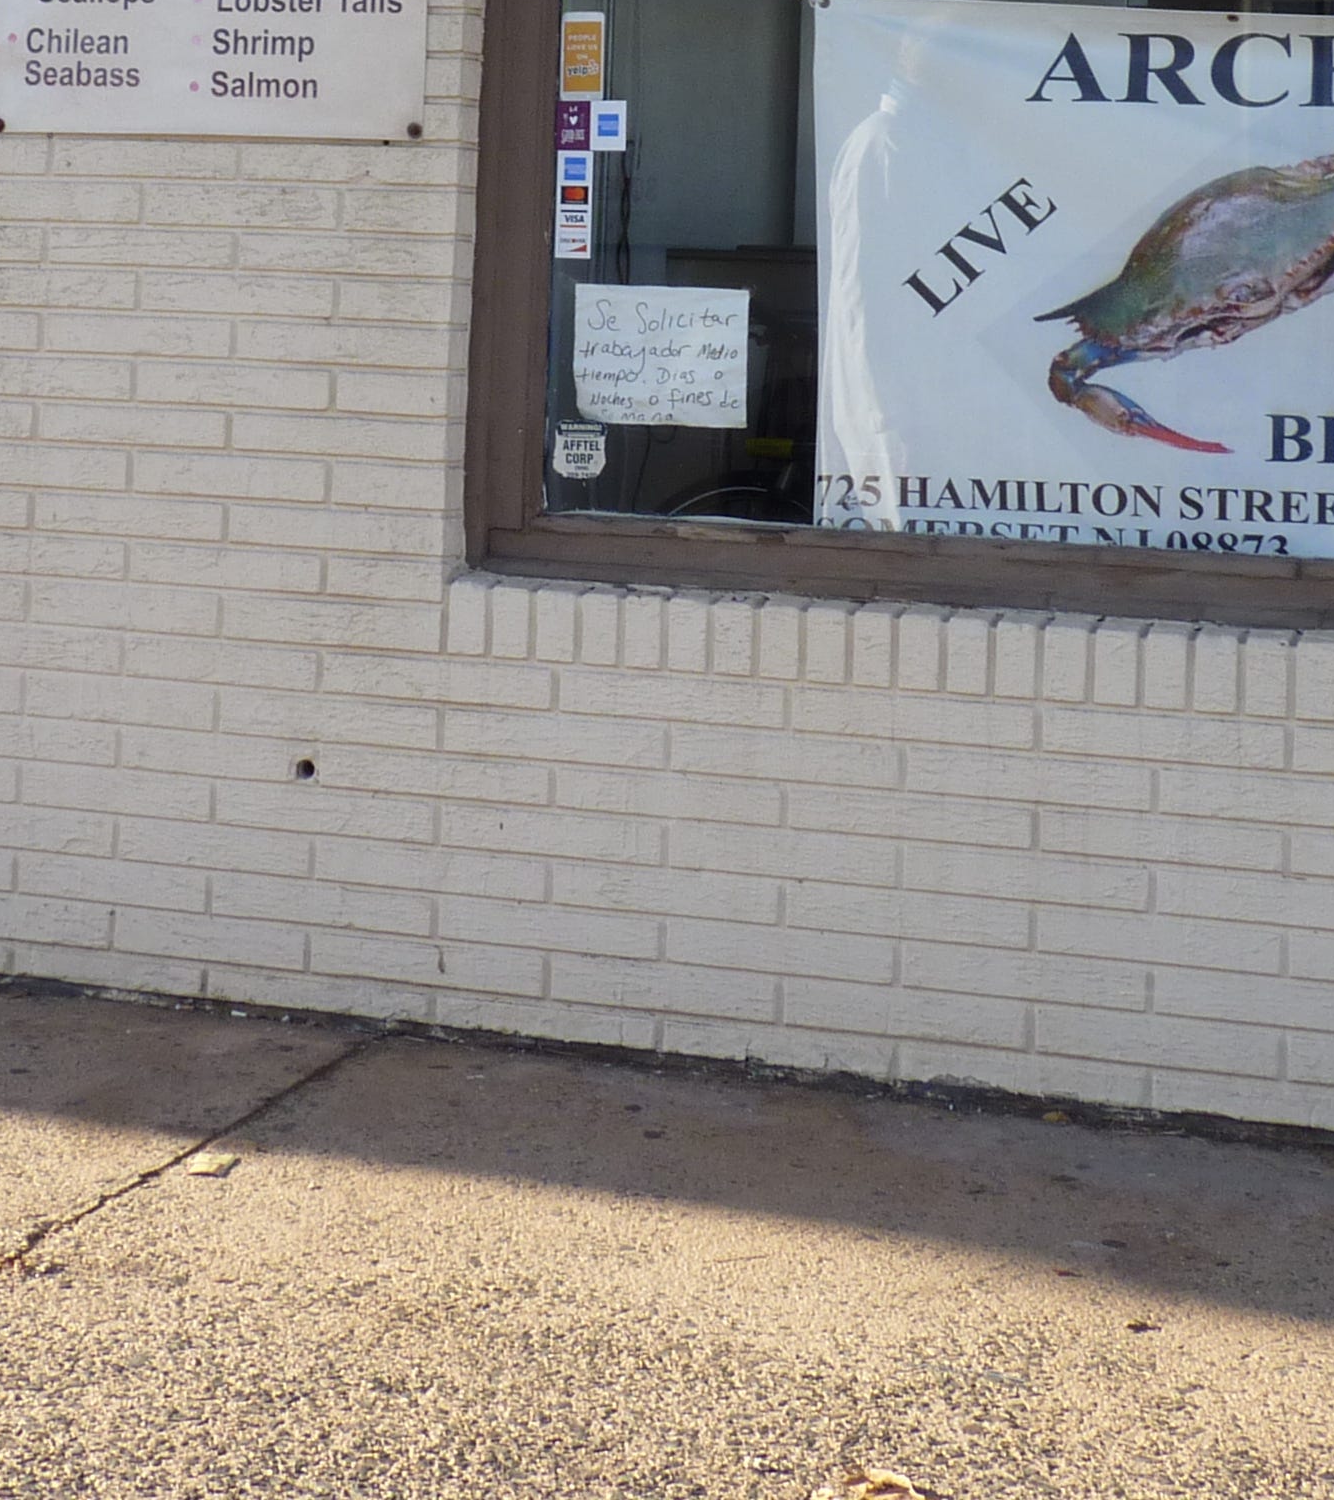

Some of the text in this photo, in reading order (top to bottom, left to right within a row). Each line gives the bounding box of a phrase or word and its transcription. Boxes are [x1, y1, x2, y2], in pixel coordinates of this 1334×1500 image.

[26, 28, 129, 55] Chilean
[212, 29, 315, 62] Shrimp
[24, 61, 140, 88] Seabass
[210, 72, 318, 99] Salmon
[564, 214, 585, 223] VISA
[902, 177, 1058, 319] LIVE
[587, 299, 739, 335] Se Solicitar
[667, 387, 714, 410] fines
[562, 439, 601, 452] AFFTEL
[817, 474, 882, 508] 725
[896, 475, 1163, 519] HAMILTON
